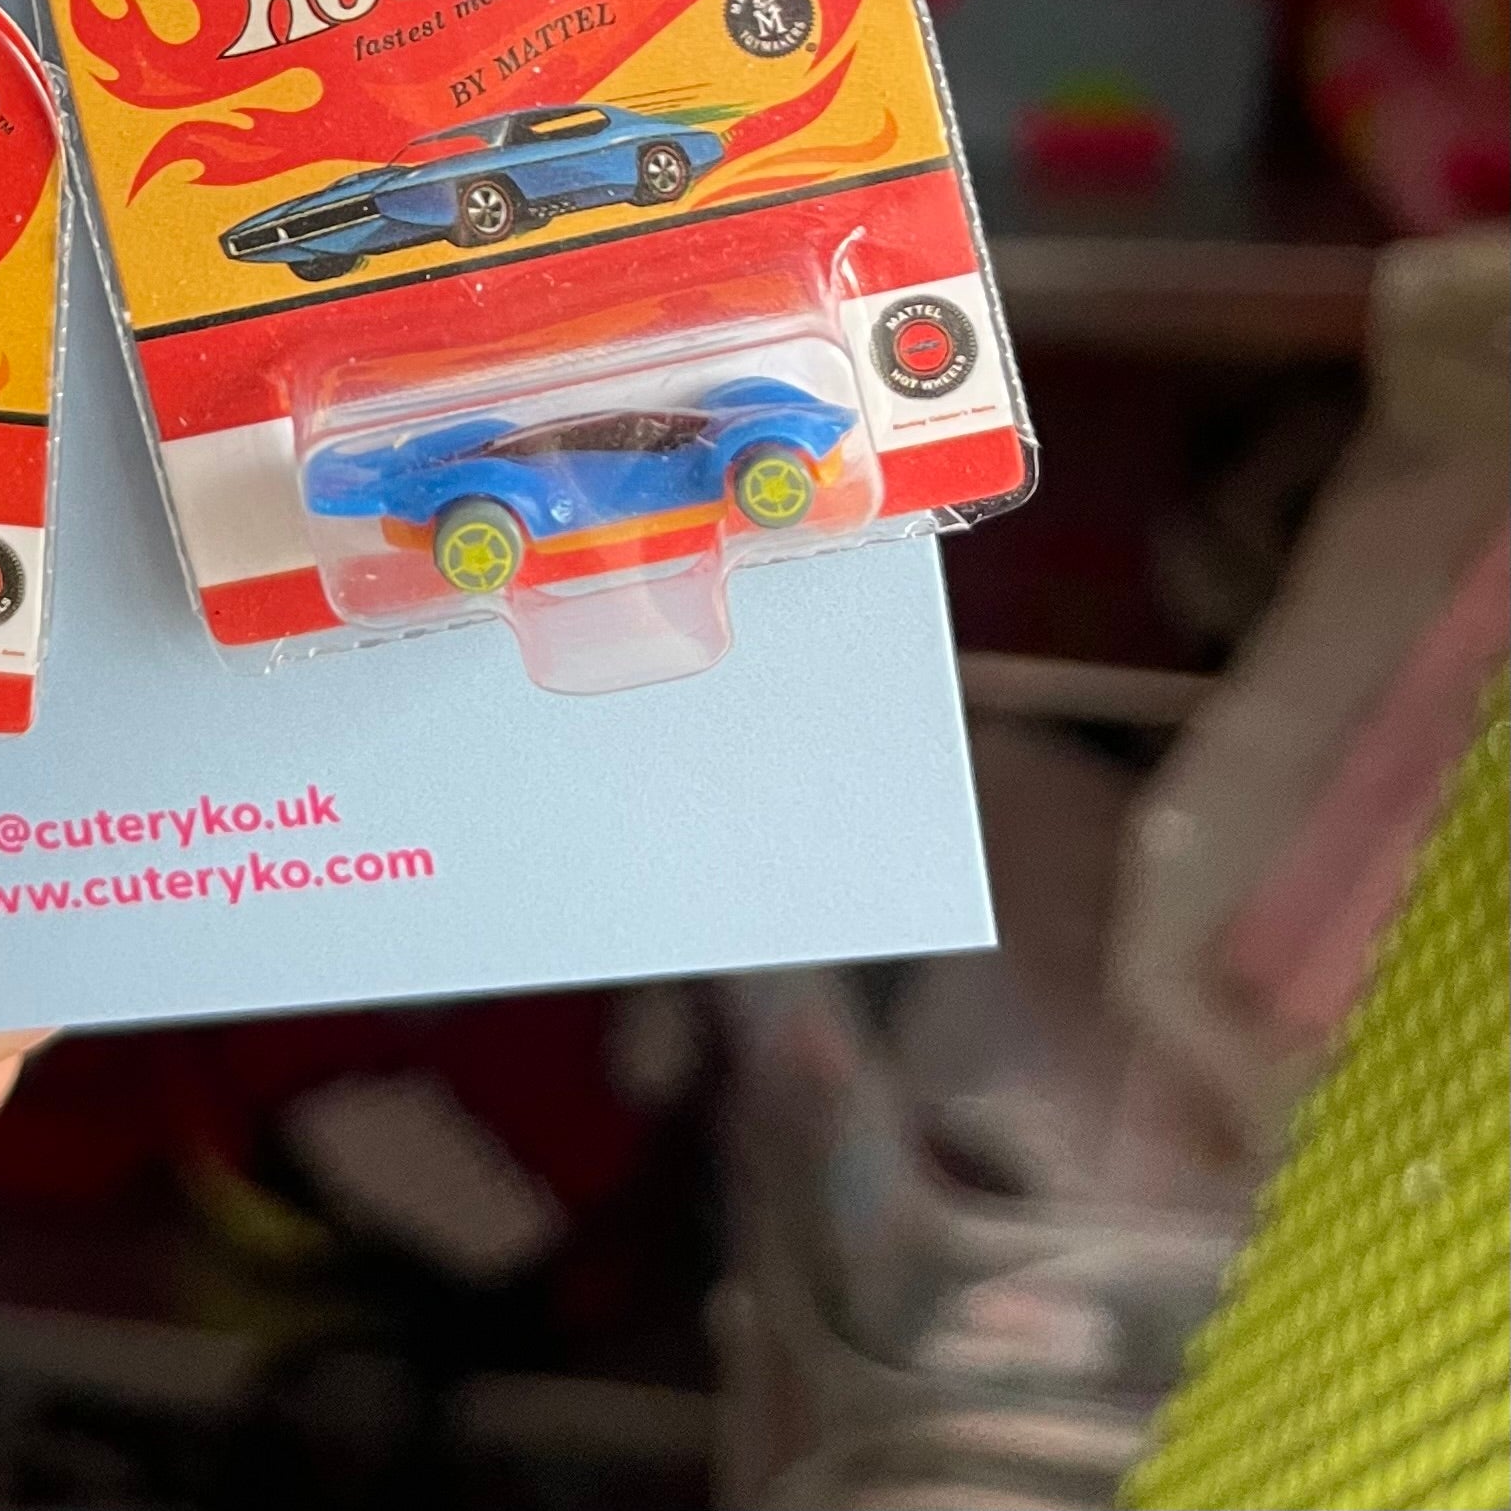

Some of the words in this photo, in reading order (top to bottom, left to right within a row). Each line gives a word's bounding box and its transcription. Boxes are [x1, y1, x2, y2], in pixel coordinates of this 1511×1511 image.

[354, 12, 445, 61] fastest
[449, 68, 487, 109] BY
[492, 2, 616, 81] MATTEL
[886, 305, 942, 330] MATTEL
[890, 368, 919, 389] HOT
